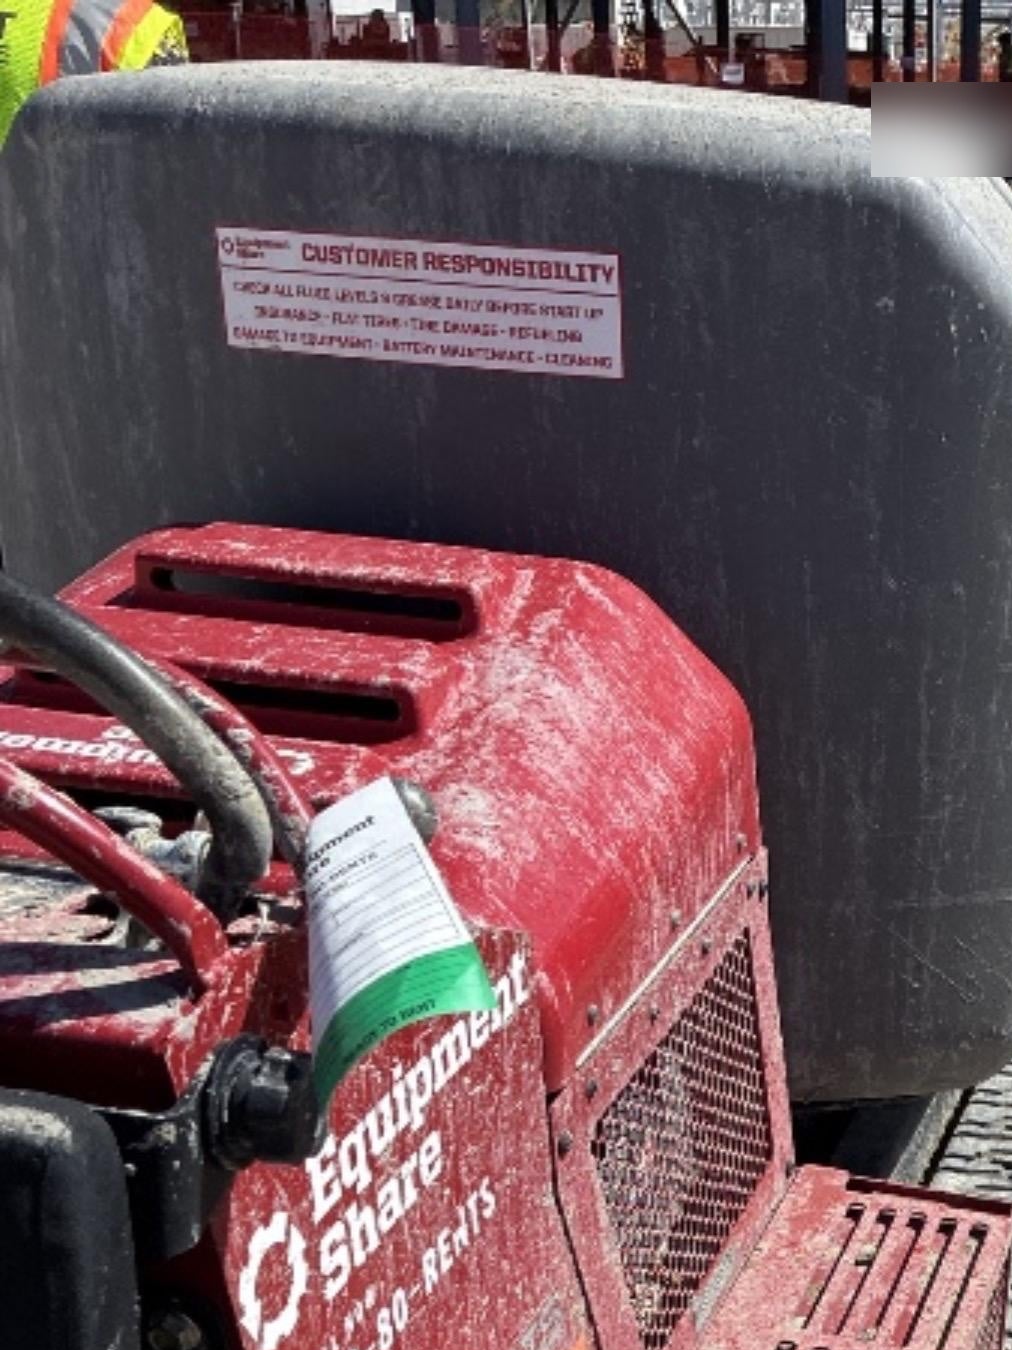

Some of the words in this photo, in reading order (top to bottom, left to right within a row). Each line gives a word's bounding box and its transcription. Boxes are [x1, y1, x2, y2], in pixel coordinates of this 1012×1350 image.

[302, 241, 418, 271] CUSTOMER
[422, 251, 615, 285] RESPONSIBILITY
[306, 953, 530, 1224] Equipment
[319, 1128, 443, 1300] Share
